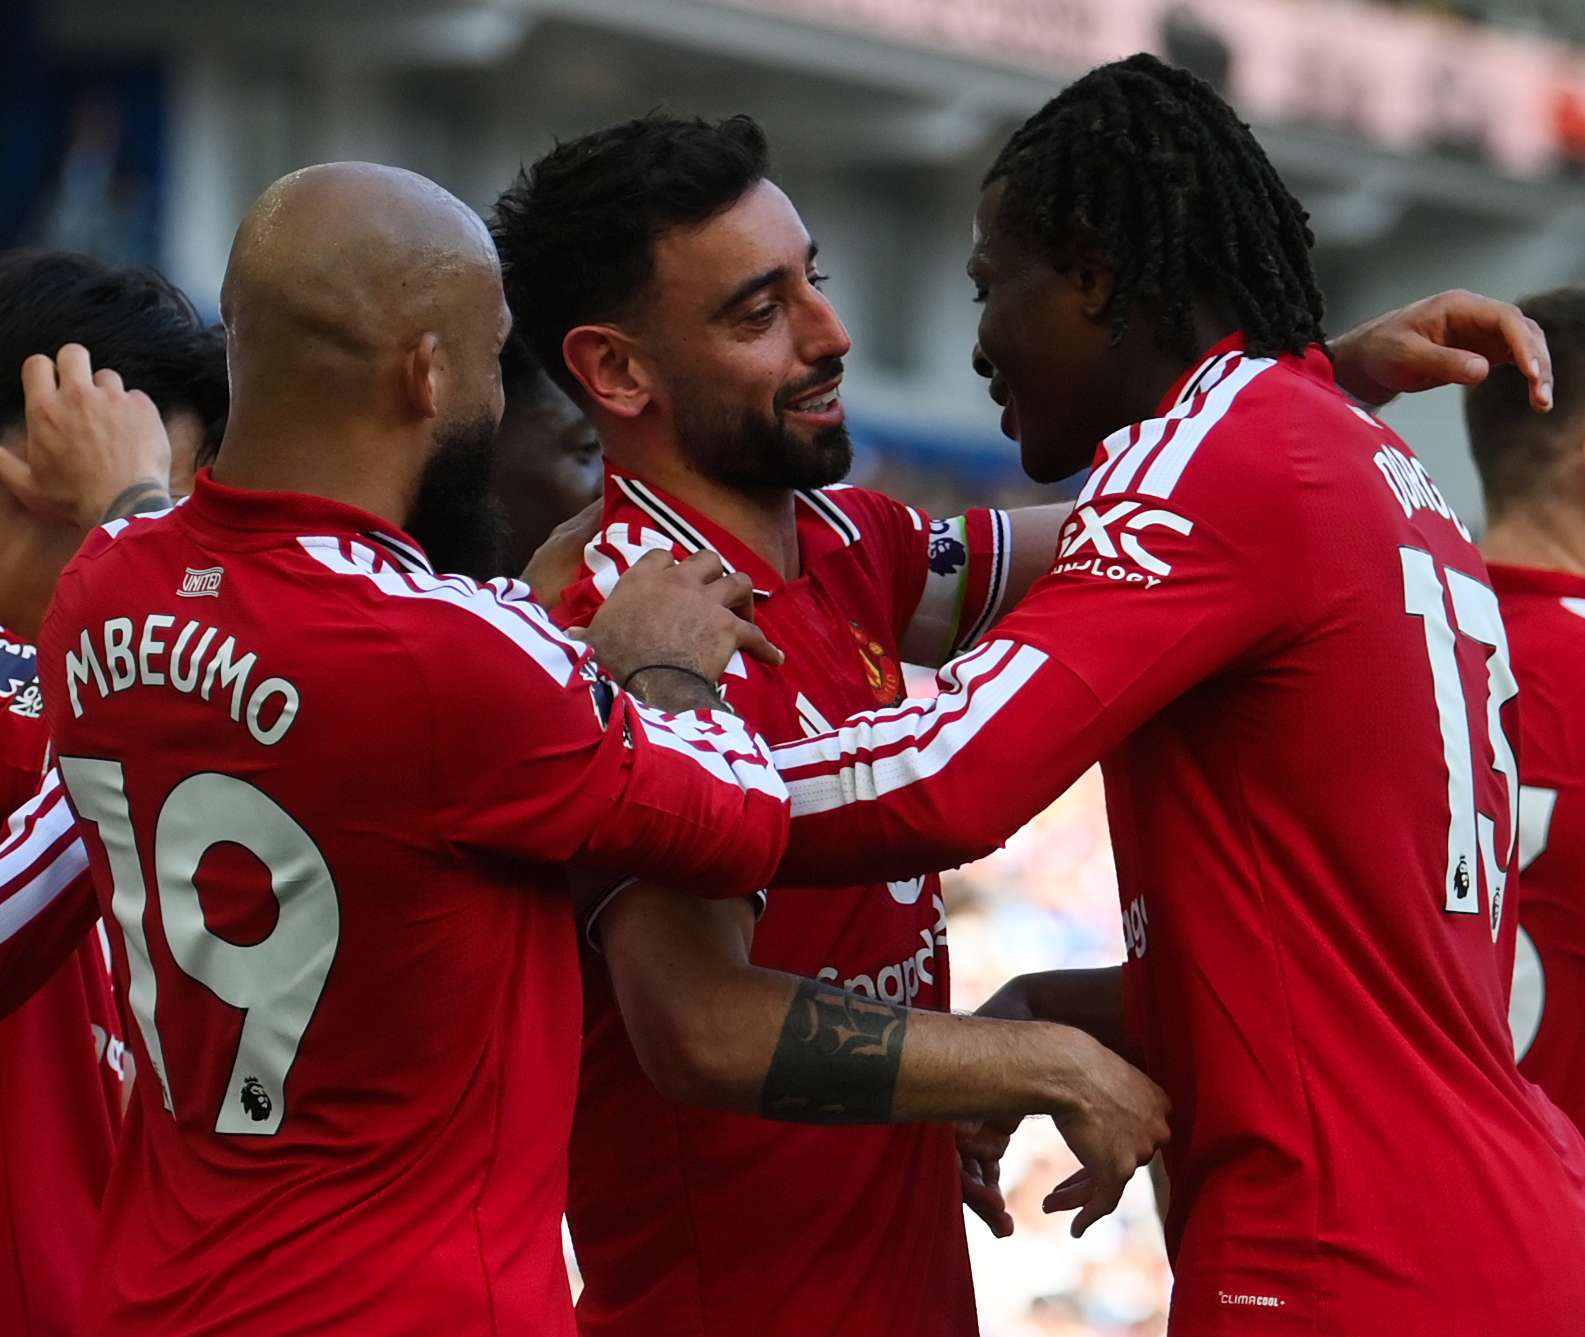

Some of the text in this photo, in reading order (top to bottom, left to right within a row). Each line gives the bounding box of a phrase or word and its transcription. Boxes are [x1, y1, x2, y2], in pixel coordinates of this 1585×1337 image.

[66, 614, 299, 745] MBEUMO
[183, 572, 222, 592] UNITED
[1398, 545, 1520, 944] 13
[58, 755, 340, 1135] 19
